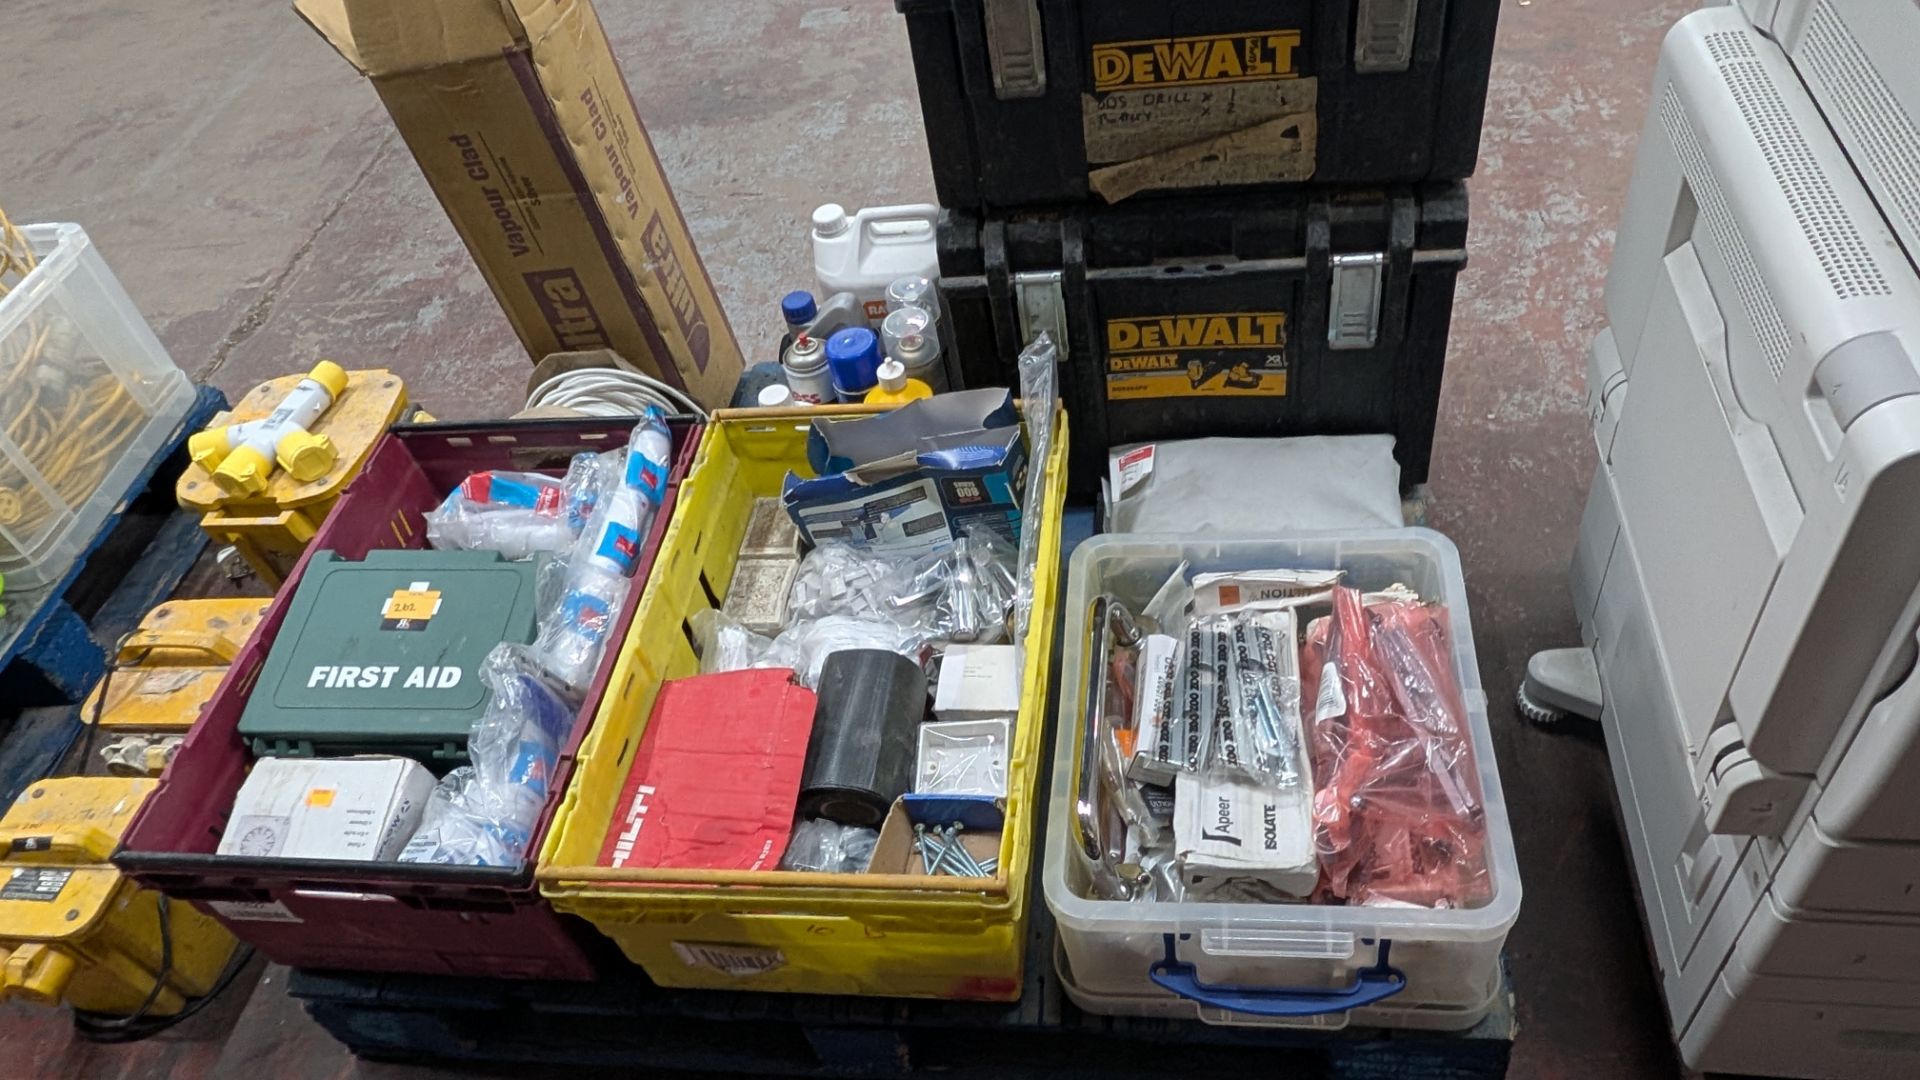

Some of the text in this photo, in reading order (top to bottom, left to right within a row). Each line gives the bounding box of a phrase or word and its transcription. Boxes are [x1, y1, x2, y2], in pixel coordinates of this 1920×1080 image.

[580, 88, 608, 141] Clad
[449, 133, 490, 181] Clad
[604, 143, 640, 221] Vapour
[482, 186, 530, 258] Vapour
[306, 665, 463, 689] FIRST AID
[1215, 796, 1230, 834] Apeer
[1264, 804, 1278, 851] ISOLATE
